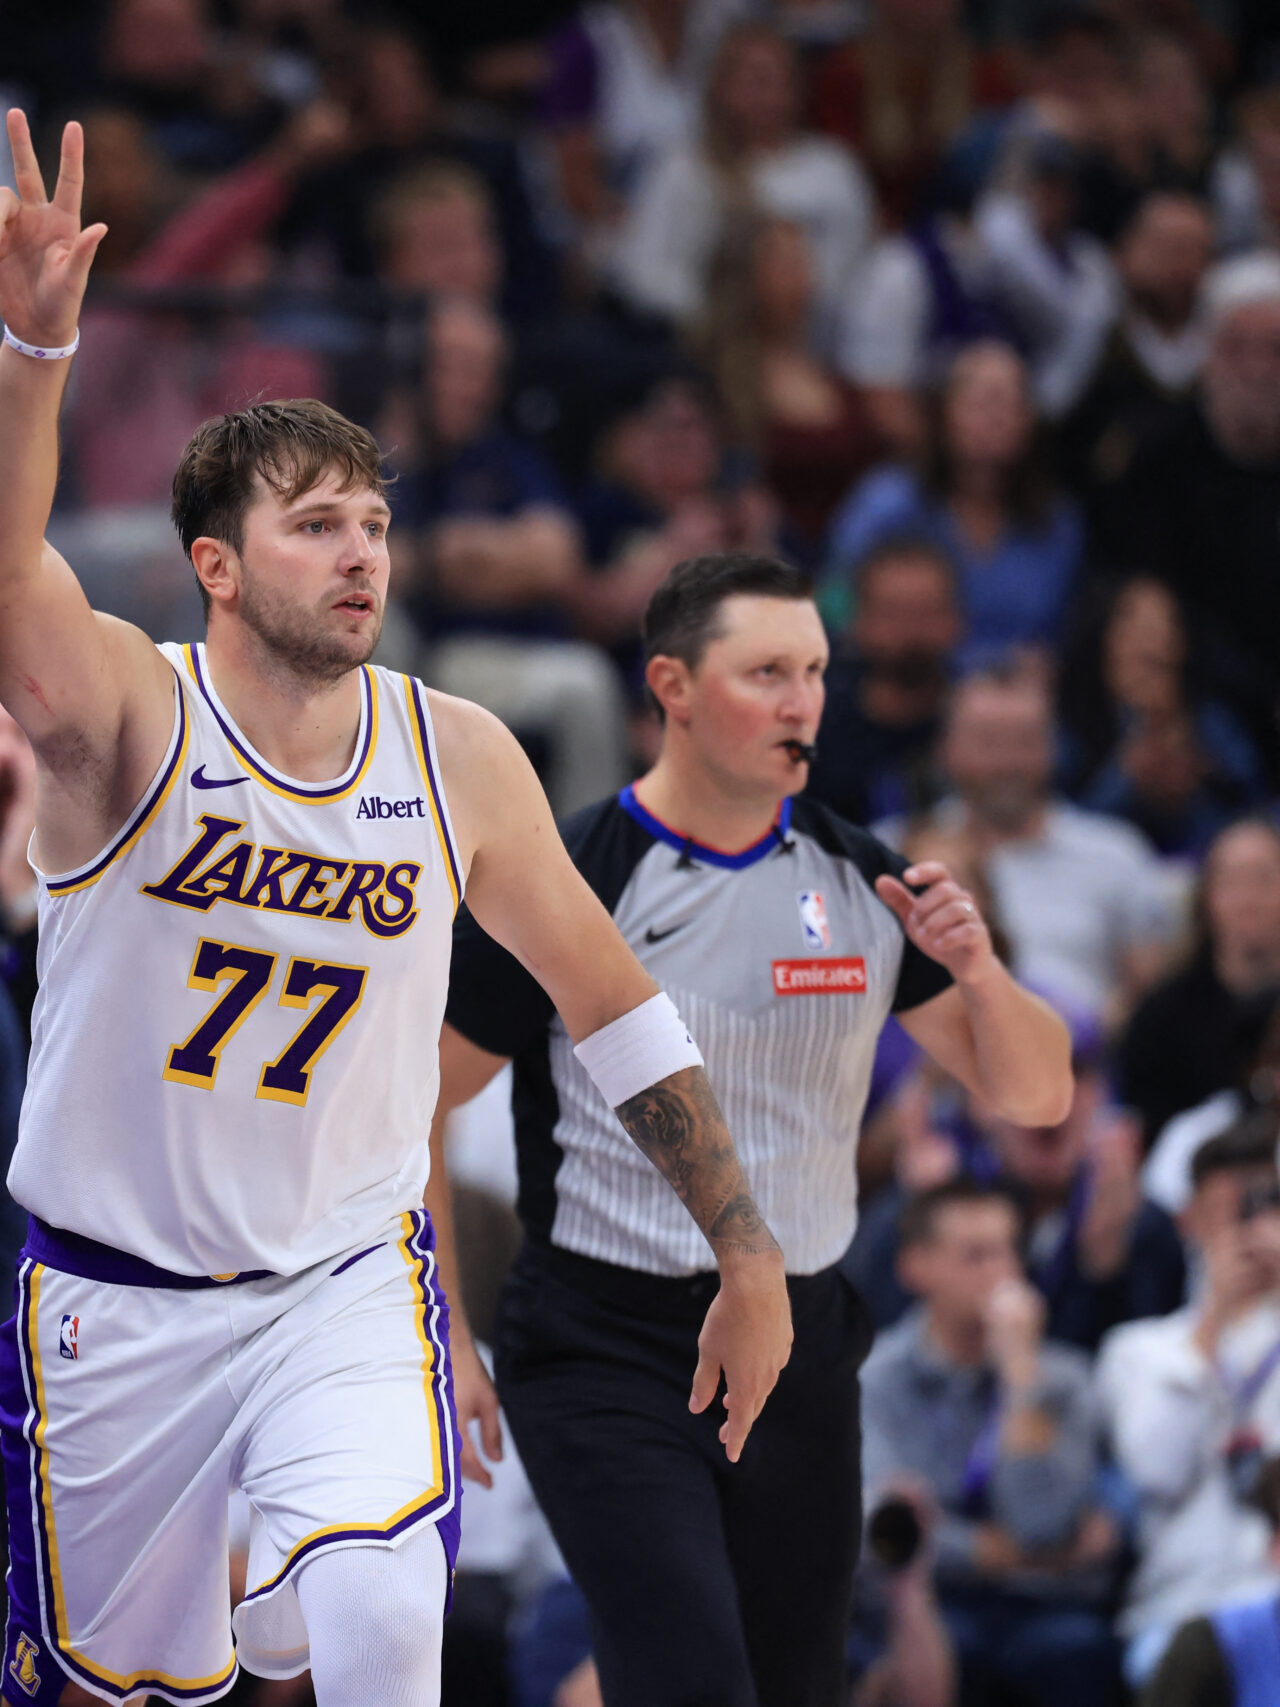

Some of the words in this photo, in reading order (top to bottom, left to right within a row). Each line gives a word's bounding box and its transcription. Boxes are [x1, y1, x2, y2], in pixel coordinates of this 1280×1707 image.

[356, 796, 426, 819] Albert
[138, 812, 424, 940] LAKERS
[774, 965, 865, 989] Emirates
[162, 936, 370, 1107] 77
